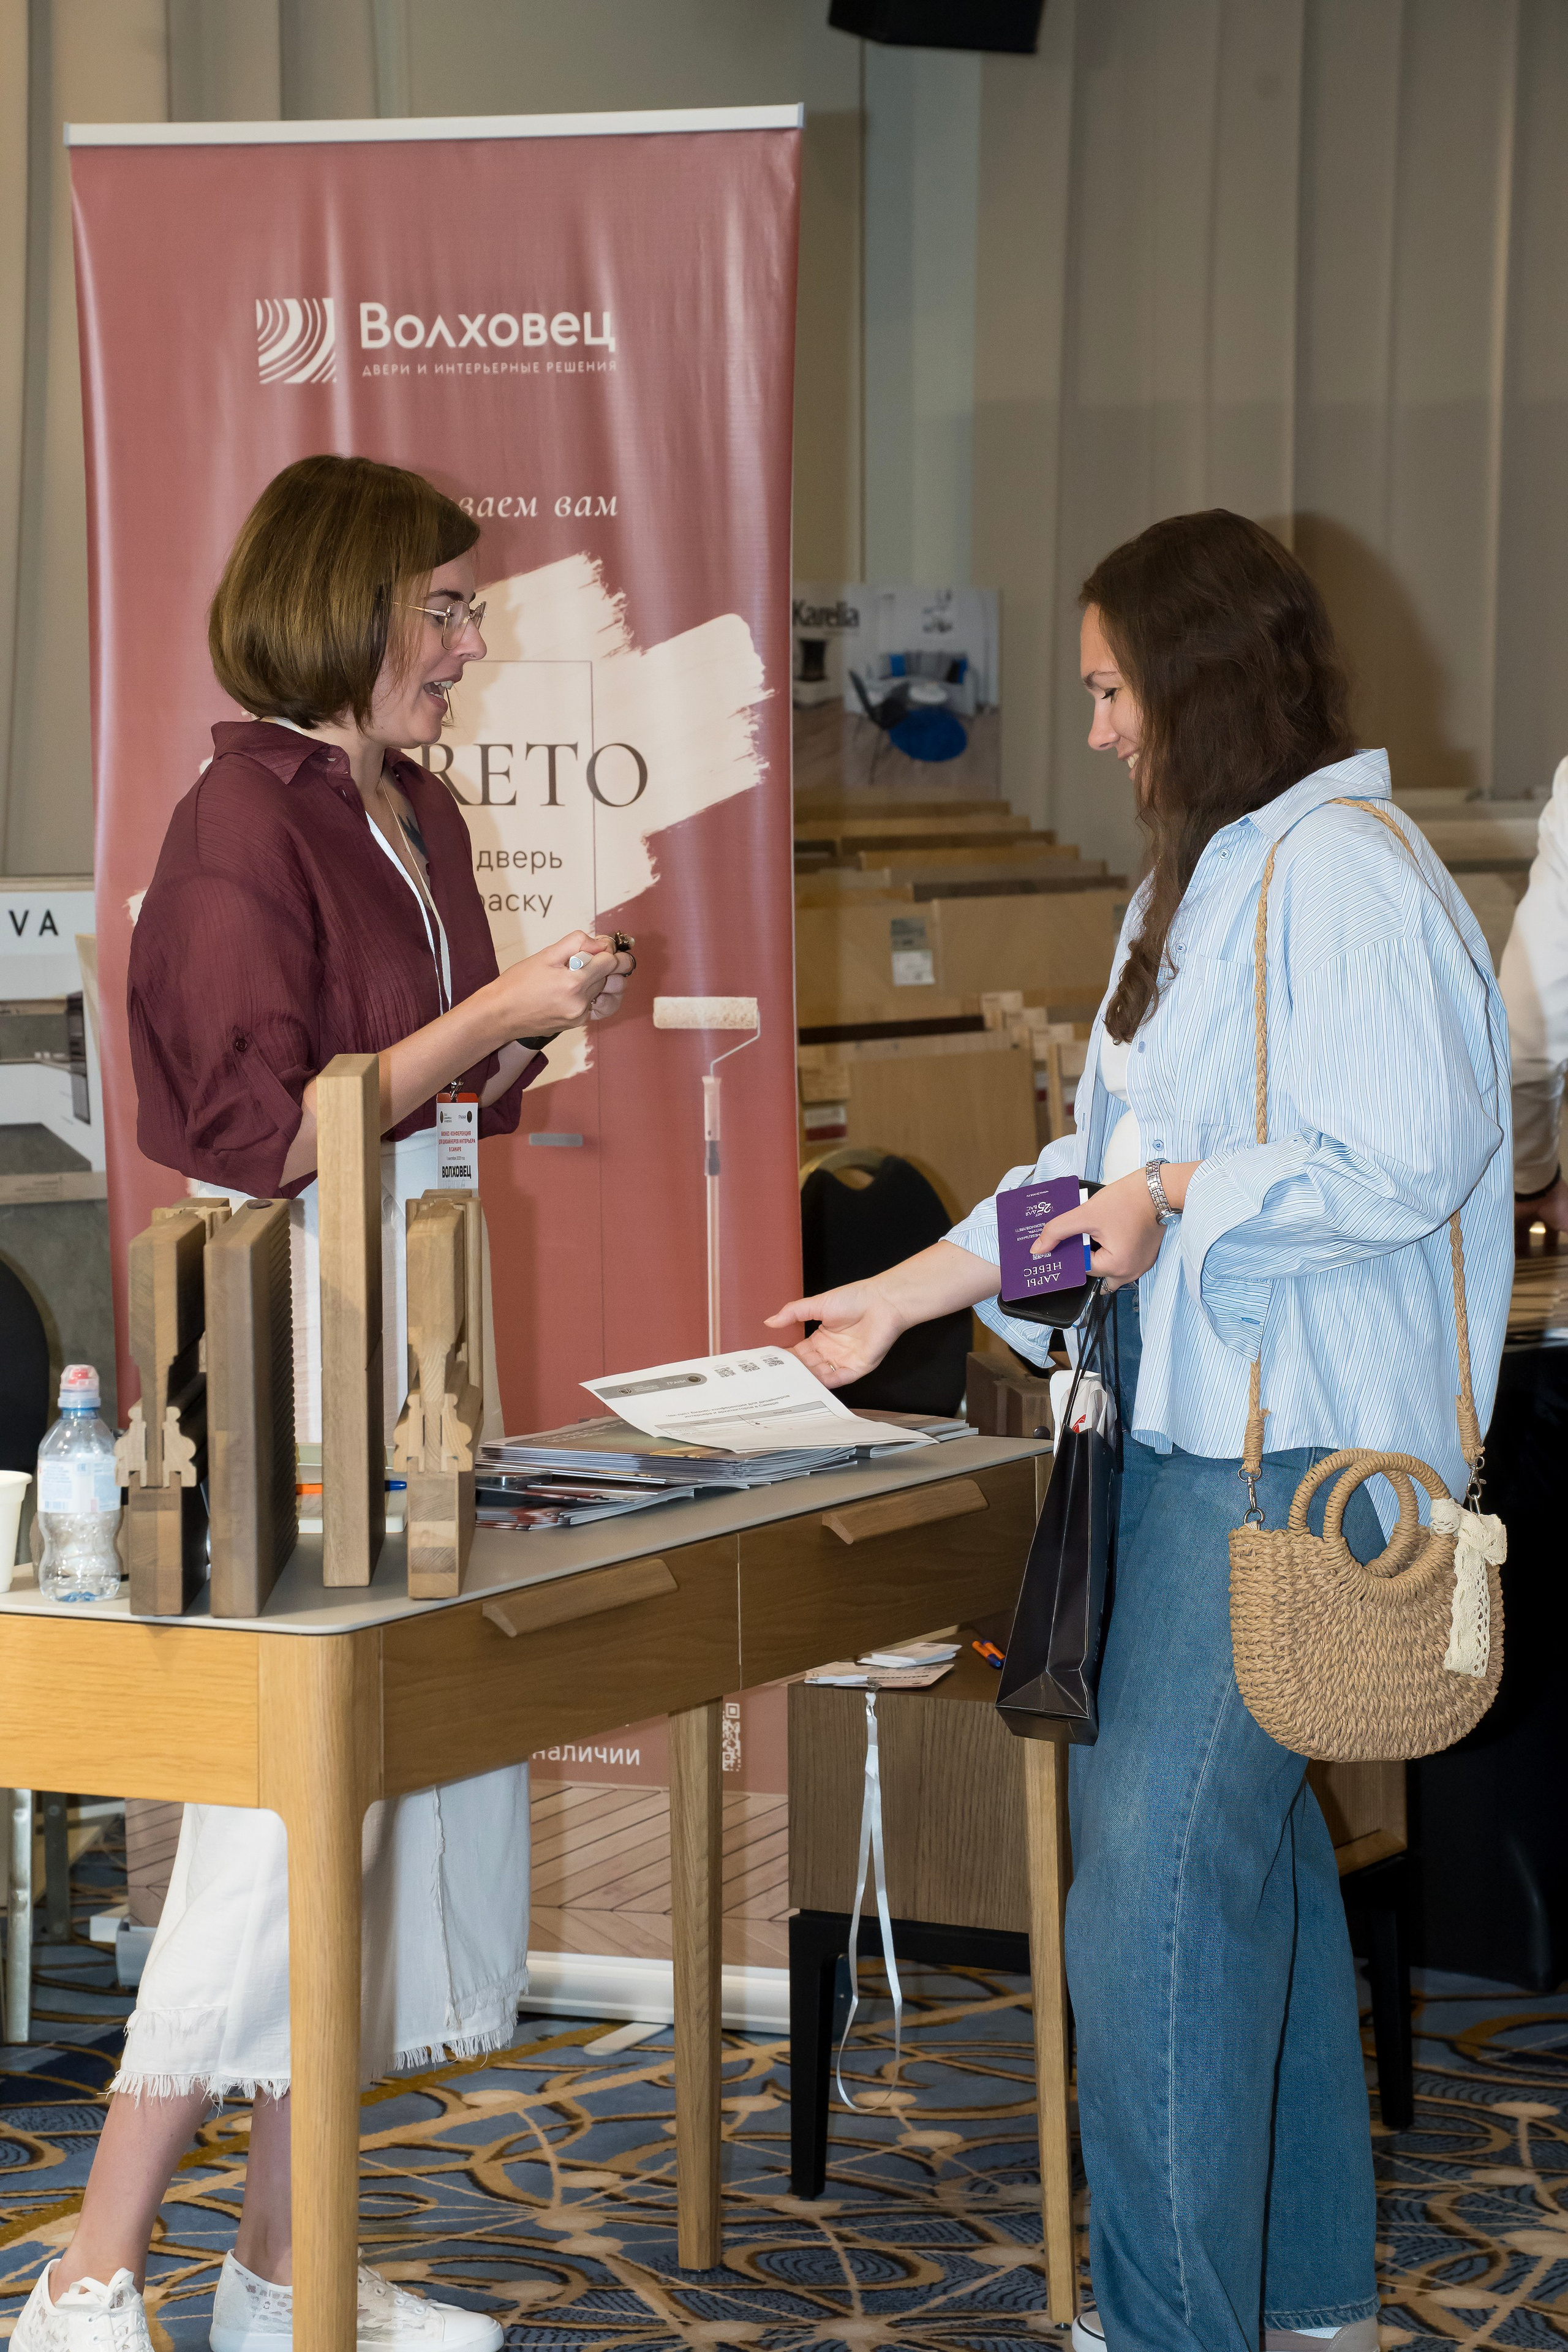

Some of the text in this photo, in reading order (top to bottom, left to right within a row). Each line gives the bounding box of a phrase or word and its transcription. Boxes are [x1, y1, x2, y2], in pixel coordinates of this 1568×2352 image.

[360, 302, 615, 352] Волховец
[362, 361, 617, 377] ДВЕРИ И ИНТЕРЬЕРНЫЕ РЕШЕНИЯ
[459, 496, 617, 518] ваем вам
[421, 742, 648, 807] RETO
[477, 850, 562, 875] дверь
[480, 894, 552, 918] аску
[442, 1165, 472, 1179] ВОЛХОВЕЦ
[1036, 1201, 1052, 1213] 25
[1023, 1261, 1062, 1277] НЕБЕС
[1027, 1272, 1061, 1287] ДАРЫ
[532, 1744, 640, 1766] наличии
